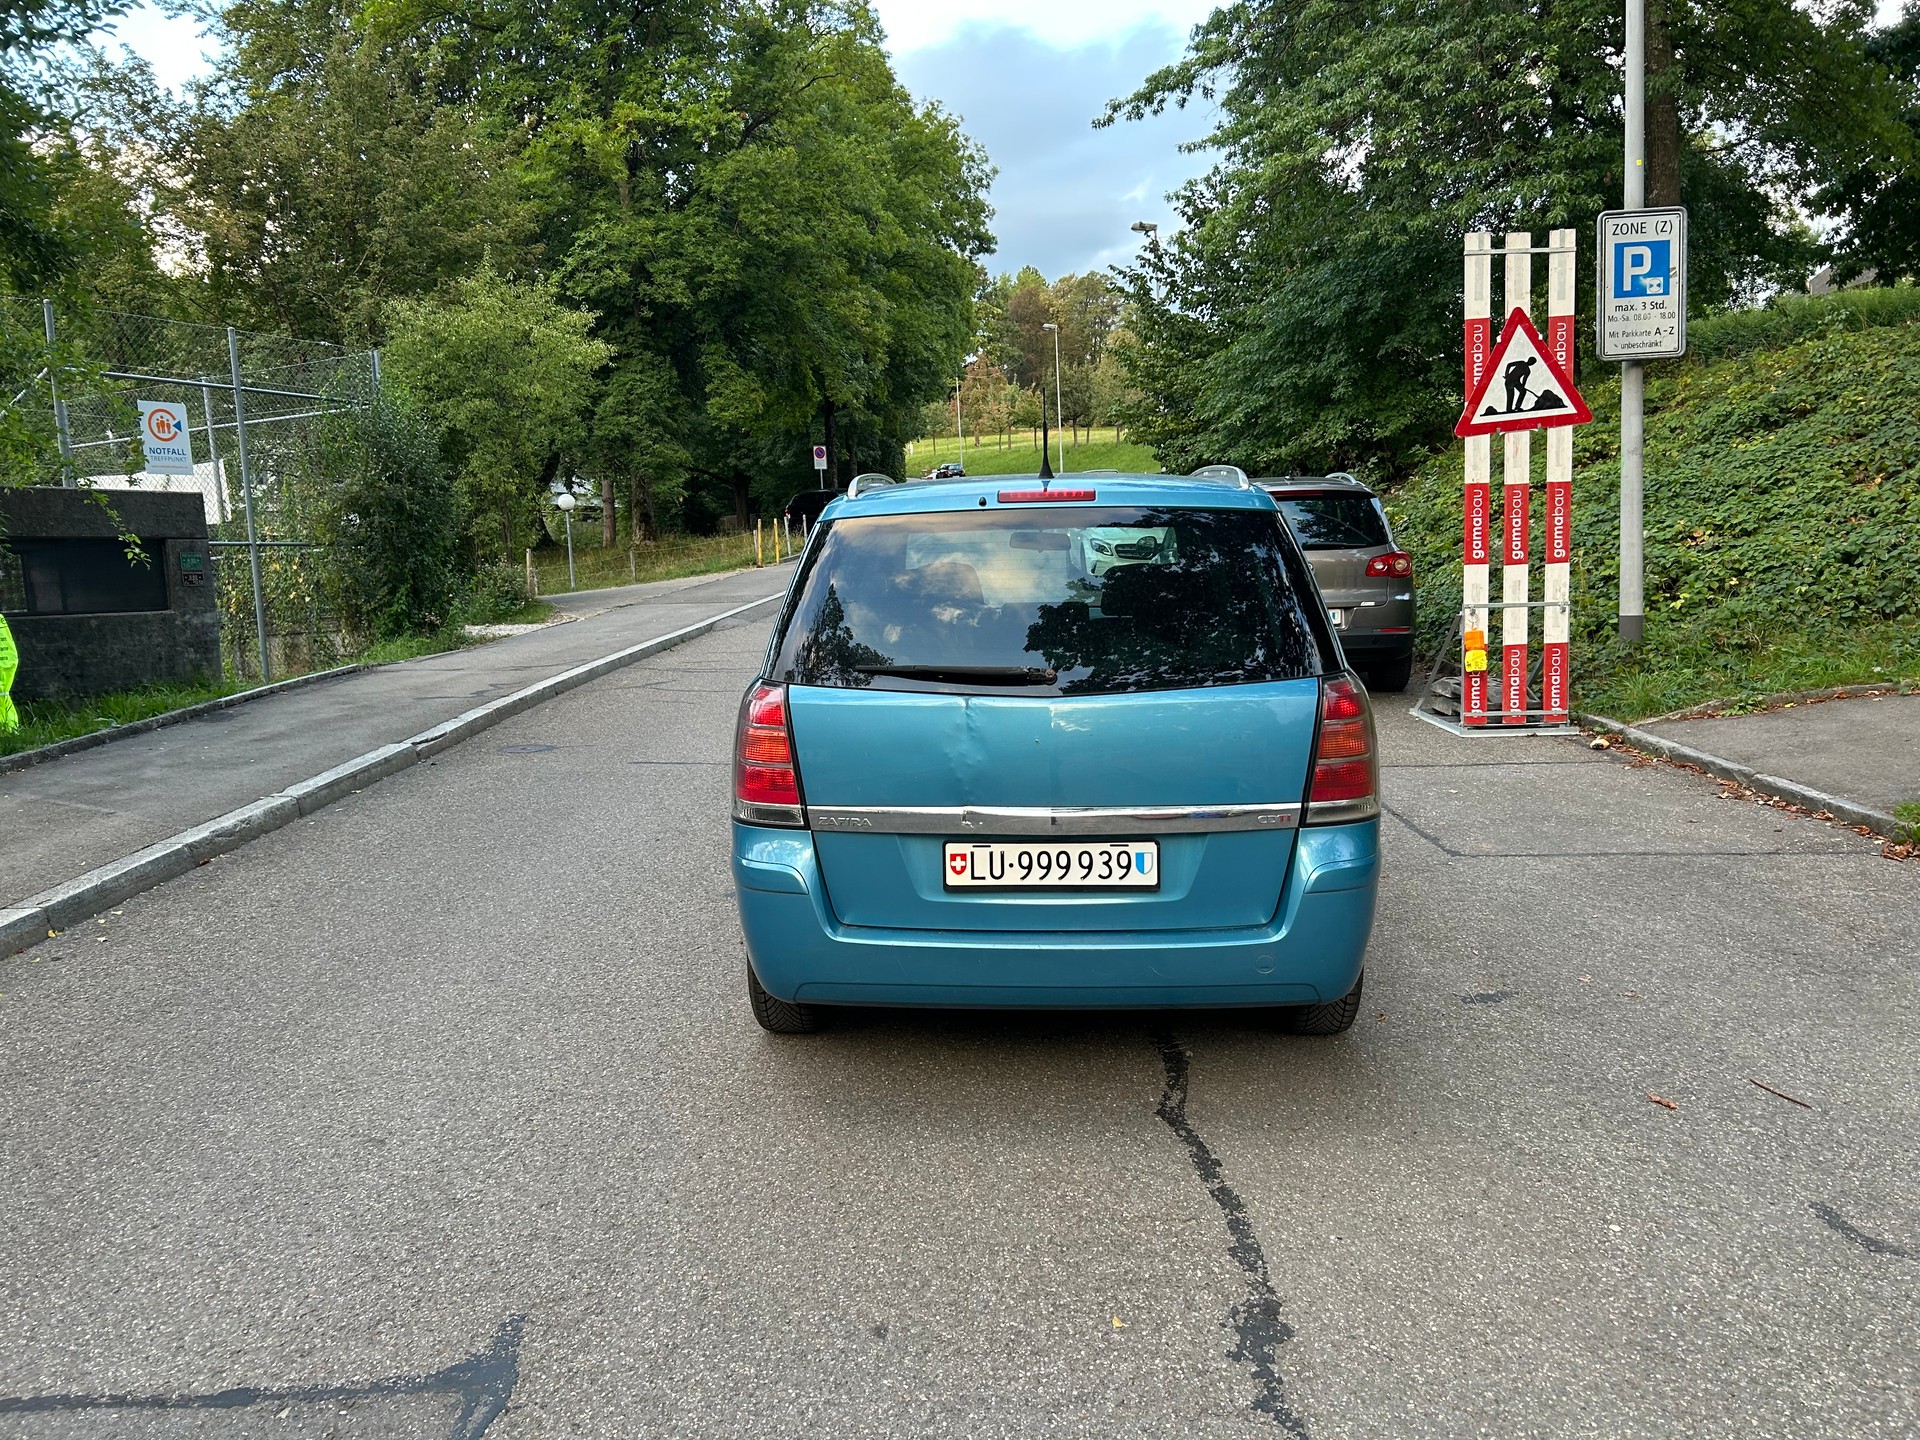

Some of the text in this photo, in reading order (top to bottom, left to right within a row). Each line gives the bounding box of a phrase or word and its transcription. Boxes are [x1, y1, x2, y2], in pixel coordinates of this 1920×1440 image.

[1612, 219, 1673, 236] ZONE (Z)
[1623, 245, 1652, 292] P
[1614, 300, 1667, 312] max. 3 Std.
[1659, 311, 1676, 320] 18.00
[1608, 330, 1620, 339] Mit
[1621, 329, 1652, 338] Parkkarte
[1470, 324, 1483, 389] amabau
[148, 447, 187, 456] NOTFALL
[1470, 489, 1485, 559] gamabau
[1509, 489, 1524, 560] gamabau
[1551, 488, 1566, 559] gamabau
[818, 816, 873, 827] ZAFIRA
